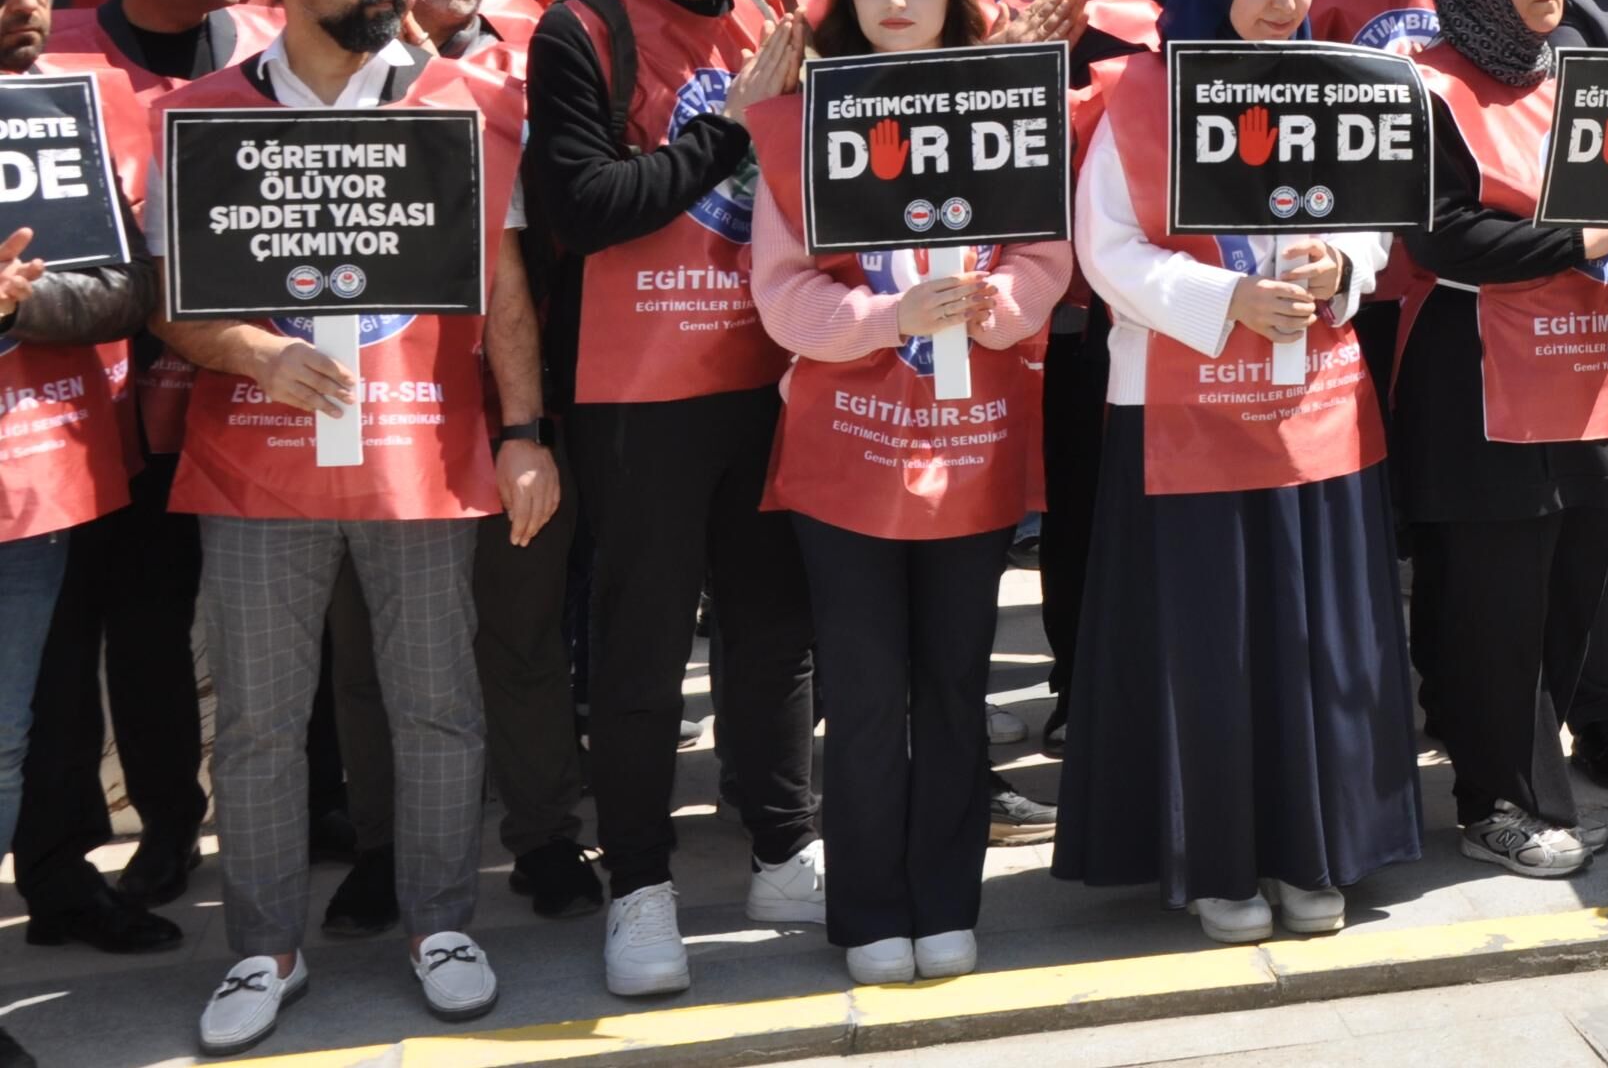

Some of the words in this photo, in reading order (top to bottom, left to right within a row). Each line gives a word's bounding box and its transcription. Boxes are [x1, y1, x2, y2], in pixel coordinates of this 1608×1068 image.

[827, 94, 950, 120] EĞİTİMCİYE
[955, 87, 1046, 115] ŞİDDETE
[1196, 79, 1319, 104] EĞİTİMCİYE
[1323, 83, 1412, 107] ŞİDDETE
[971, 118, 1049, 171] DE
[1337, 113, 1413, 162] DE
[236, 140, 407, 170] ÖĞRETMEN
[0, 148, 89, 203] DE
[260, 170, 386, 200] ÖLÜYOR
[209, 204, 321, 234] ŞİDDET
[328, 202, 435, 227] YASASI
[250, 231, 400, 262] ÇIKMIYOR
